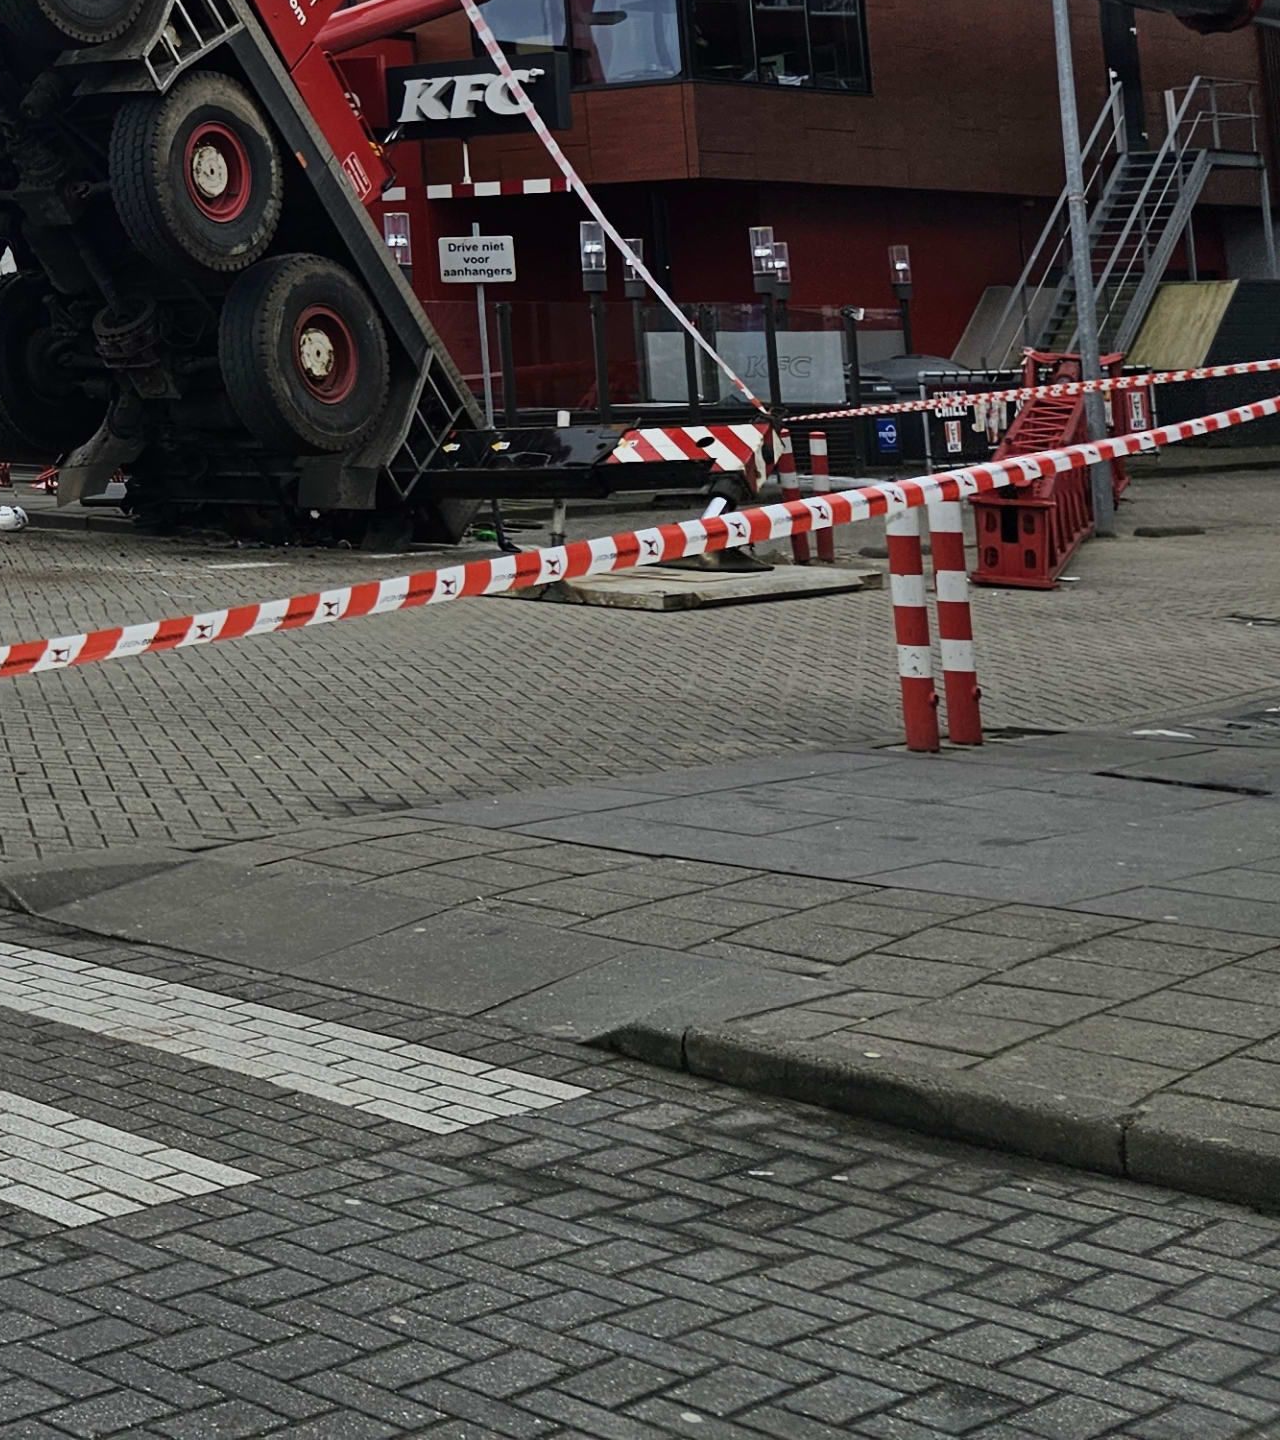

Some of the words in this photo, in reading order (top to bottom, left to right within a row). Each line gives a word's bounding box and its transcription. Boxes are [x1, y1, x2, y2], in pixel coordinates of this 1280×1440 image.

[397, 69, 544, 123] KFC
[448, 242, 478, 252] Drive
[482, 241, 504, 252] niet
[444, 267, 512, 278] aanhangers
